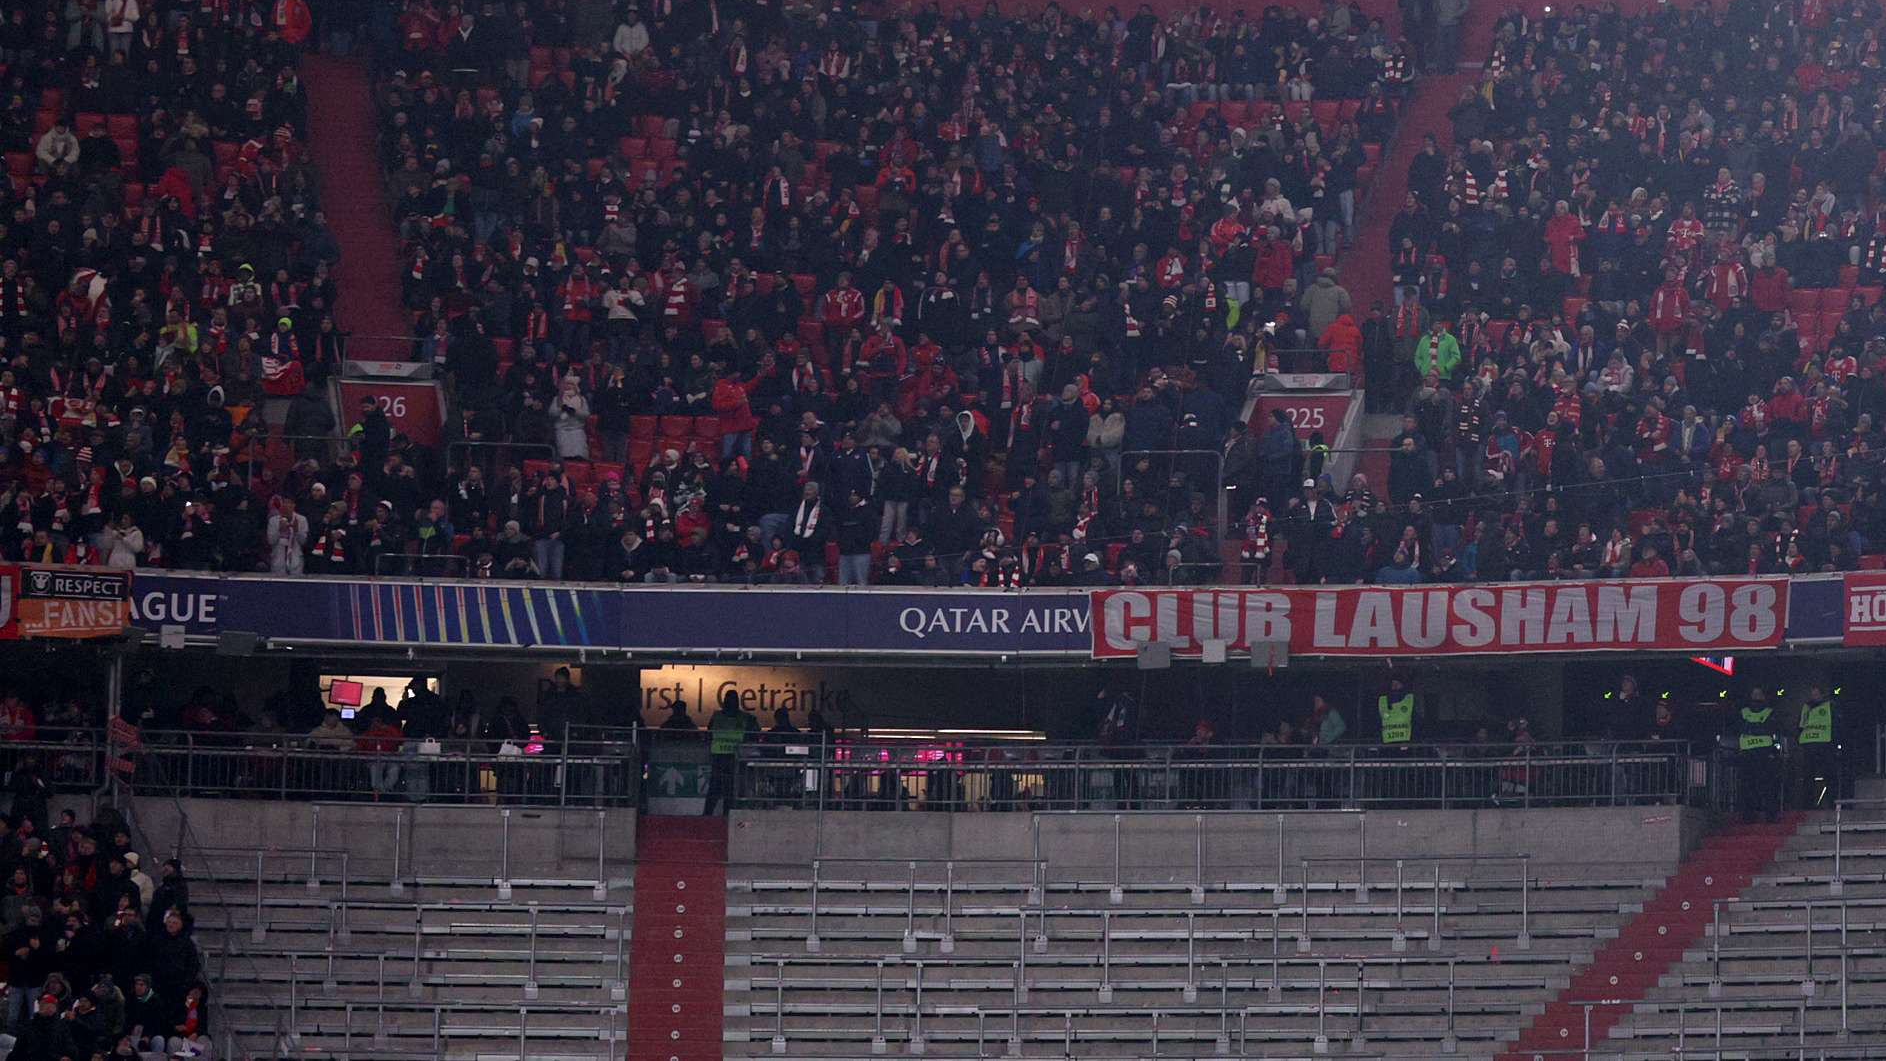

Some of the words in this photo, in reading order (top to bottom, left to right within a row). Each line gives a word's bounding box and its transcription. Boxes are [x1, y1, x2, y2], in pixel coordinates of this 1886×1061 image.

[379, 396, 406, 417] 26
[1286, 407, 1325, 428] 225
[54, 577, 124, 596] RESPECT
[899, 607, 1011, 638] QATAR
[1103, 592, 1292, 650] CLUB
[1313, 585, 1658, 649] LAUSHAM
[1678, 583, 1777, 642] 98
